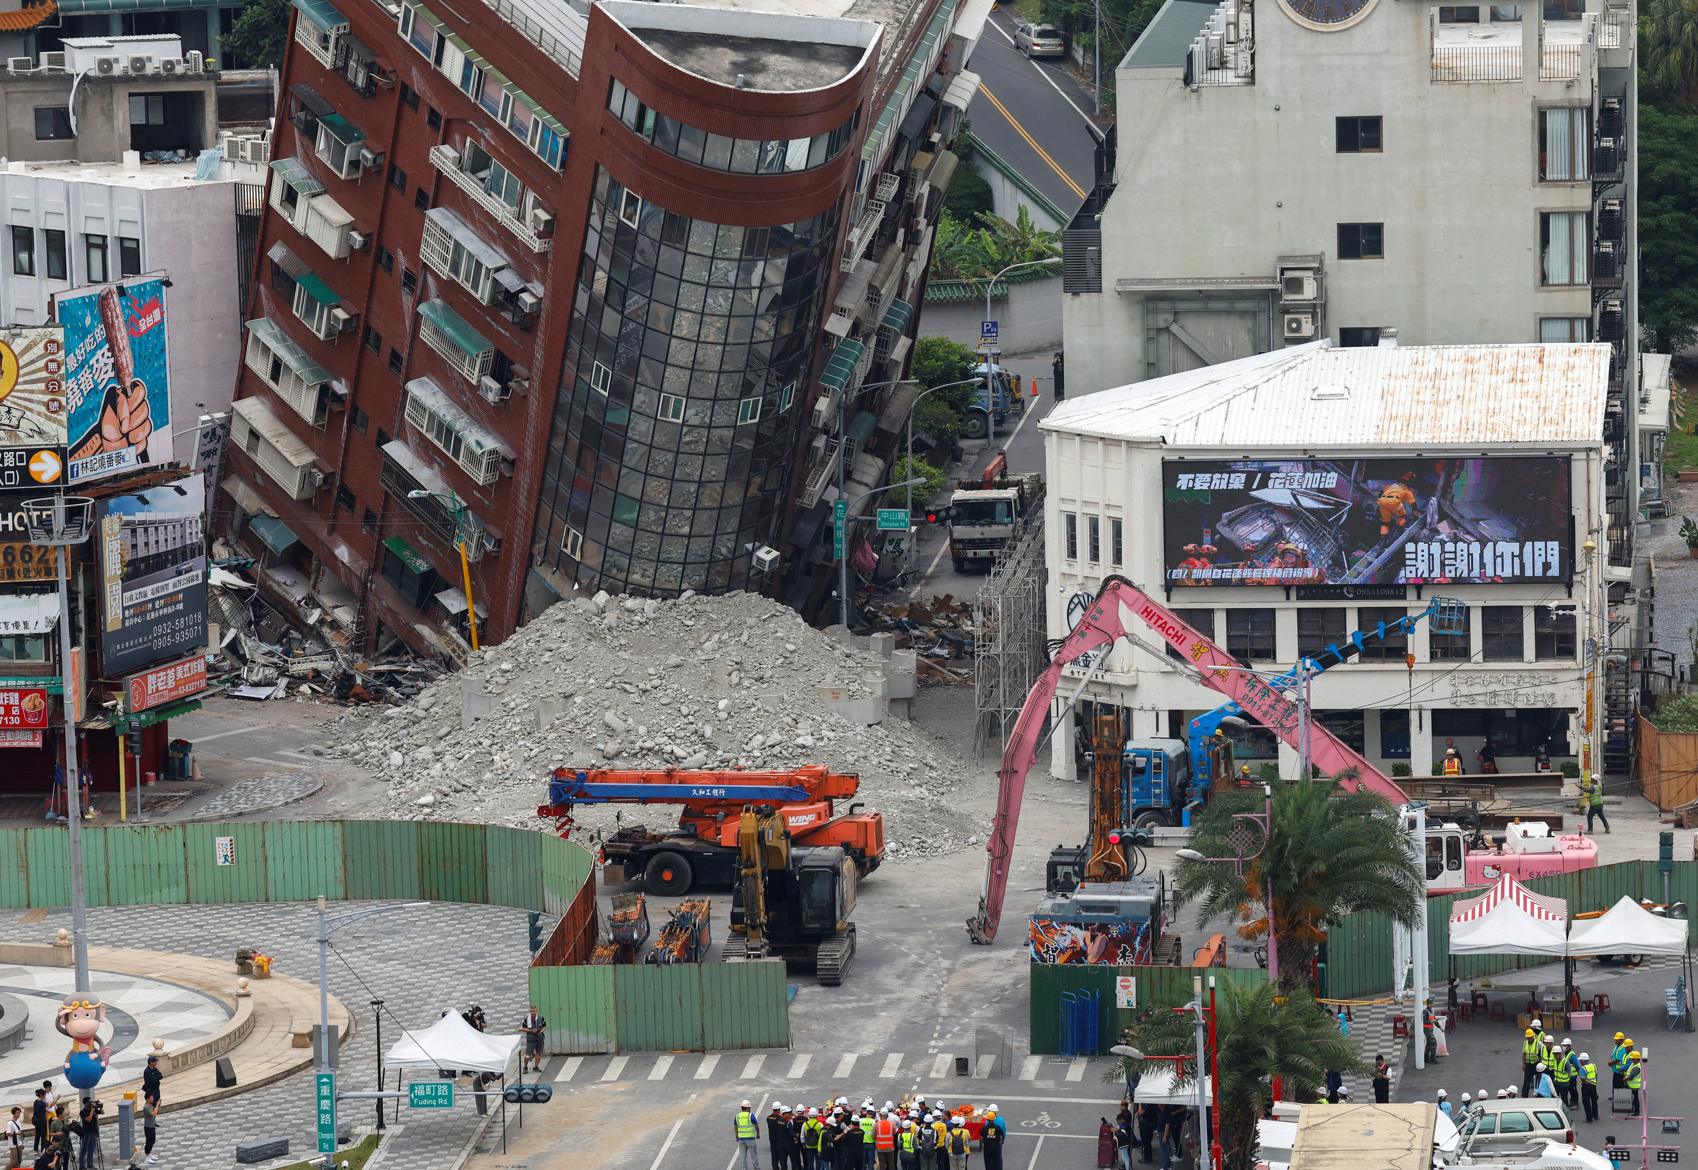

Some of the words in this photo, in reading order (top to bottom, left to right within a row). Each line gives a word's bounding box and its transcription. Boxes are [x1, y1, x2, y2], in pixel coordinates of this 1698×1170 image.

[138, 307, 162, 333] 全台灣
[65, 323, 107, 374] 最好吃的
[46, 342, 60, 412] 別無分號
[80, 451, 123, 475] 林記燒番麥
[1176, 473, 1247, 490] 不要放棄
[1267, 472, 1339, 489] 花蓮加油
[0, 511, 52, 532] HOT
[881, 512, 906, 520] 中山路
[1405, 541, 1560, 578] 謝謝你們
[1356, 588, 1404, 596] 0955109812
[0, 620, 38, 631] 享優惠!
[152, 612, 202, 637] 0932-581018
[1140, 605, 1187, 646] HITACHI
[152, 625, 202, 650] 0905-935071
[178, 679, 206, 694] 03-8327130
[0, 692, 19, 705] 炸雞
[1244, 676, 1295, 722] 拆除工程
[692, 788, 726, 797] 久和工程行
[788, 813, 816, 823] WING
[413, 1084, 449, 1096] 福町路
[319, 1085, 332, 1125] 重慶路
[413, 1098, 437, 1107] Fuding
